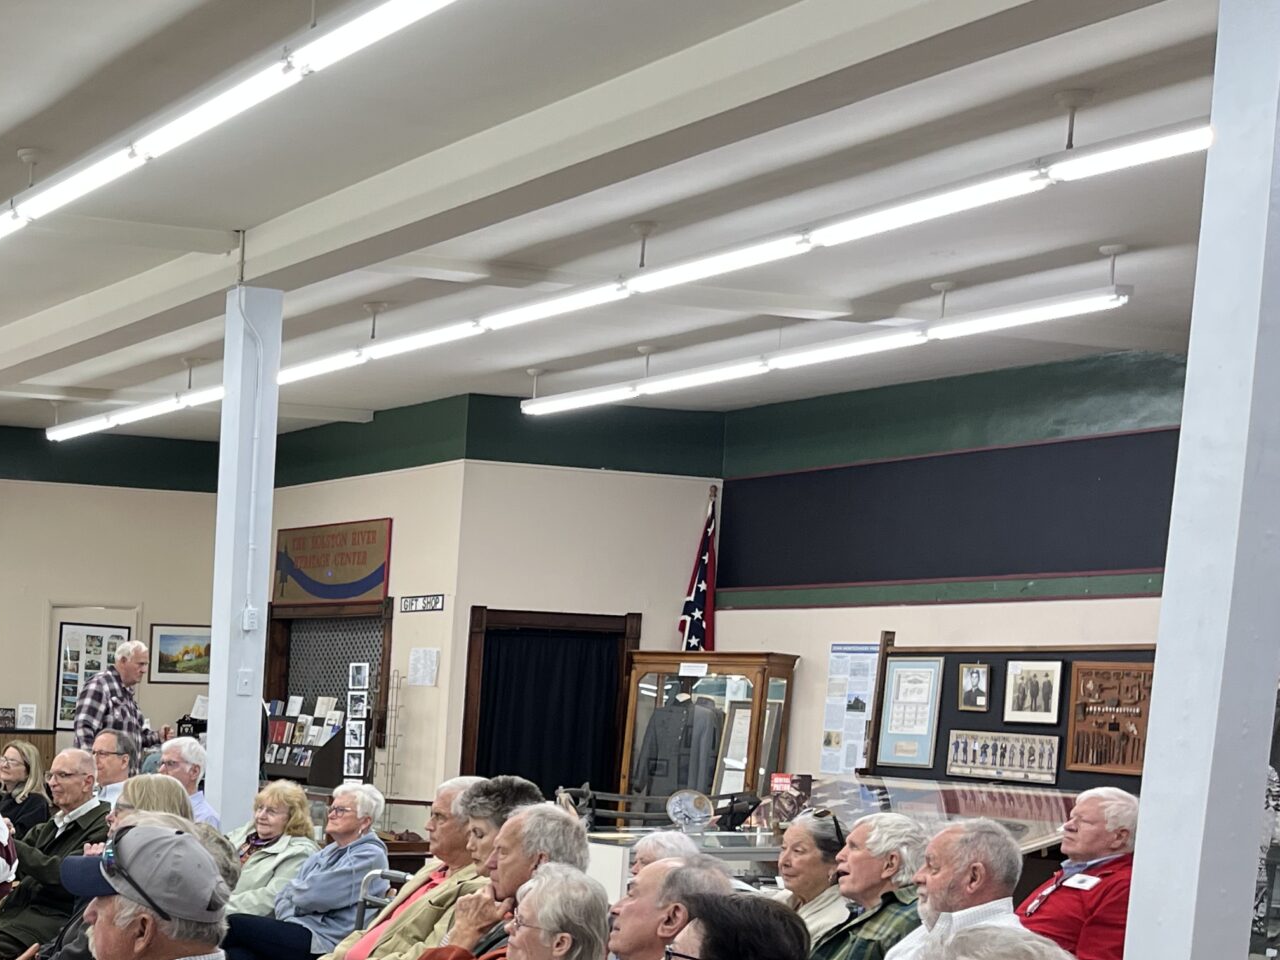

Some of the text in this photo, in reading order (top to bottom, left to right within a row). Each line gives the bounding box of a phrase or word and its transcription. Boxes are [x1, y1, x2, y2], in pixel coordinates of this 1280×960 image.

[351, 530, 377, 546] RIVER
[334, 551, 368, 567] CENTER
[403, 597, 440, 610] GIFT SHOP
